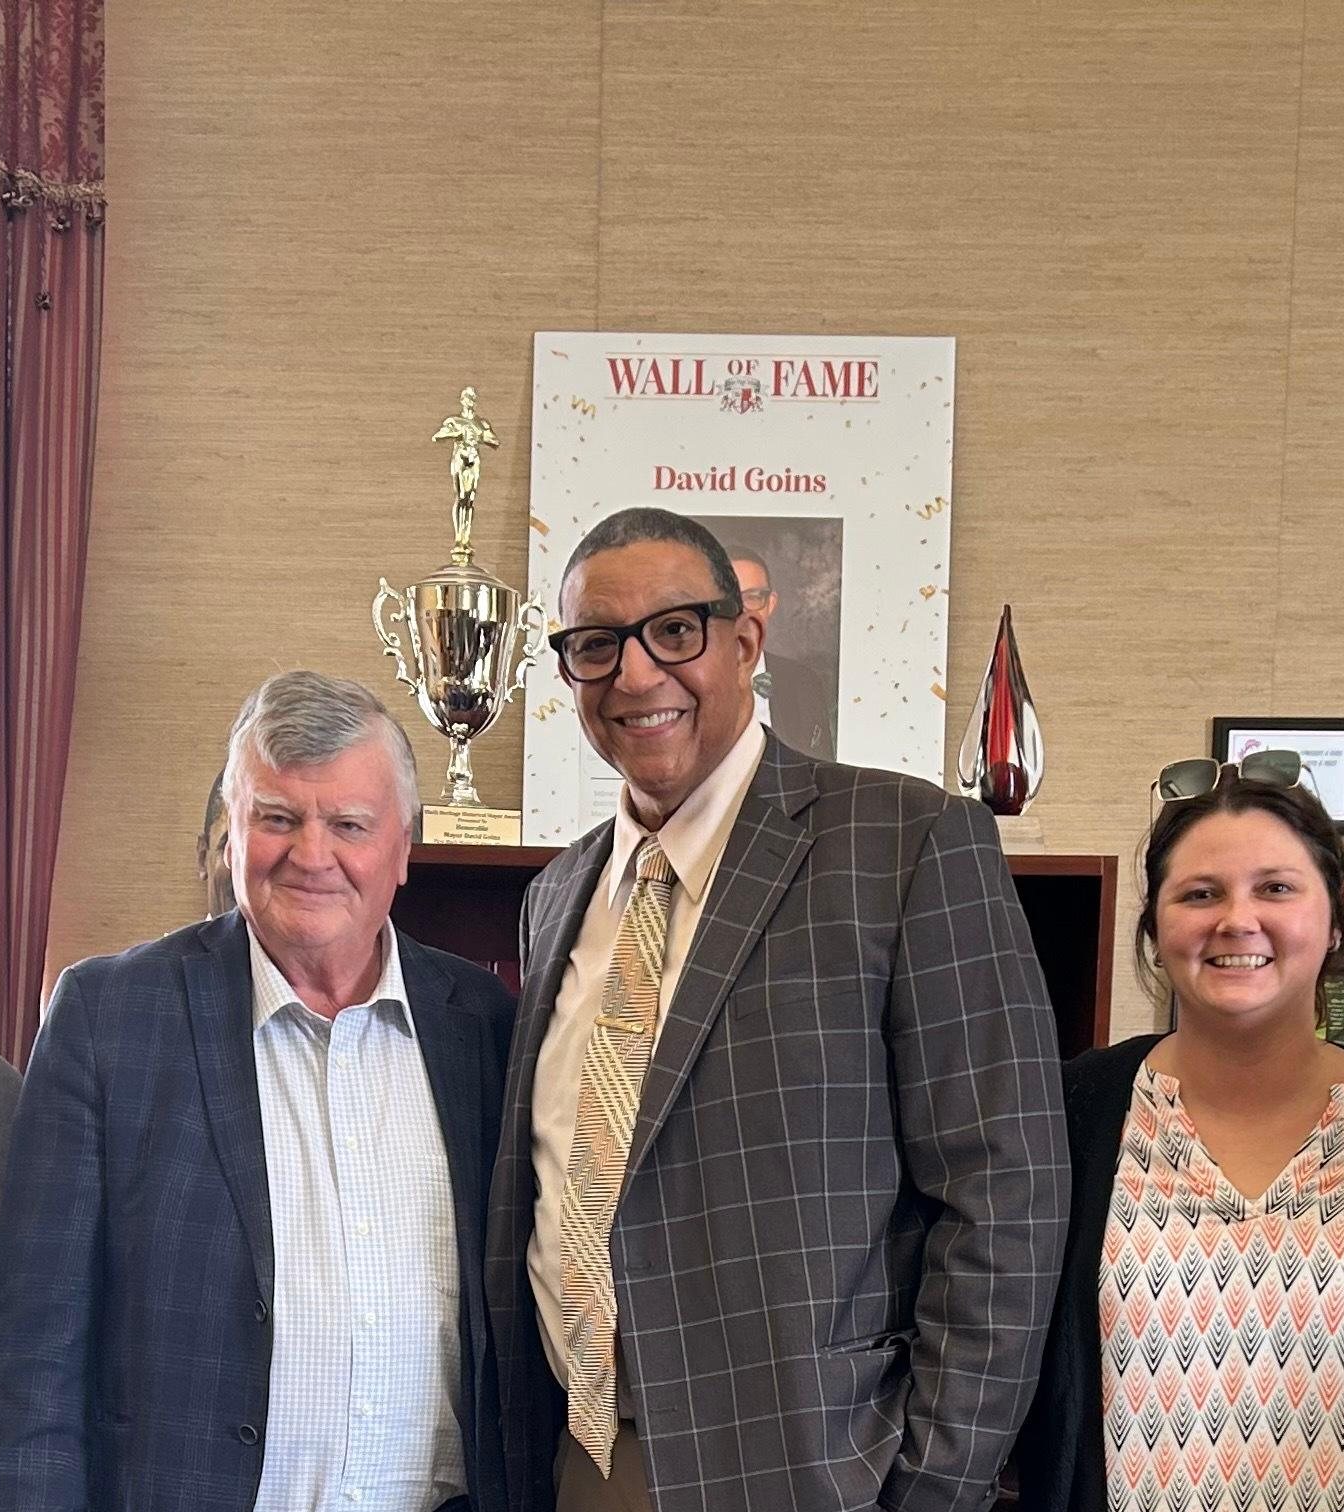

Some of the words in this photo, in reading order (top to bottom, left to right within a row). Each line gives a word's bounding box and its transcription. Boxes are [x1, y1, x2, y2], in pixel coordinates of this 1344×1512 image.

[606, 357, 715, 396] WALL
[726, 359, 761, 377] OF
[771, 360, 880, 398] FAME
[653, 465, 737, 491] David
[743, 466, 827, 493] Goins
